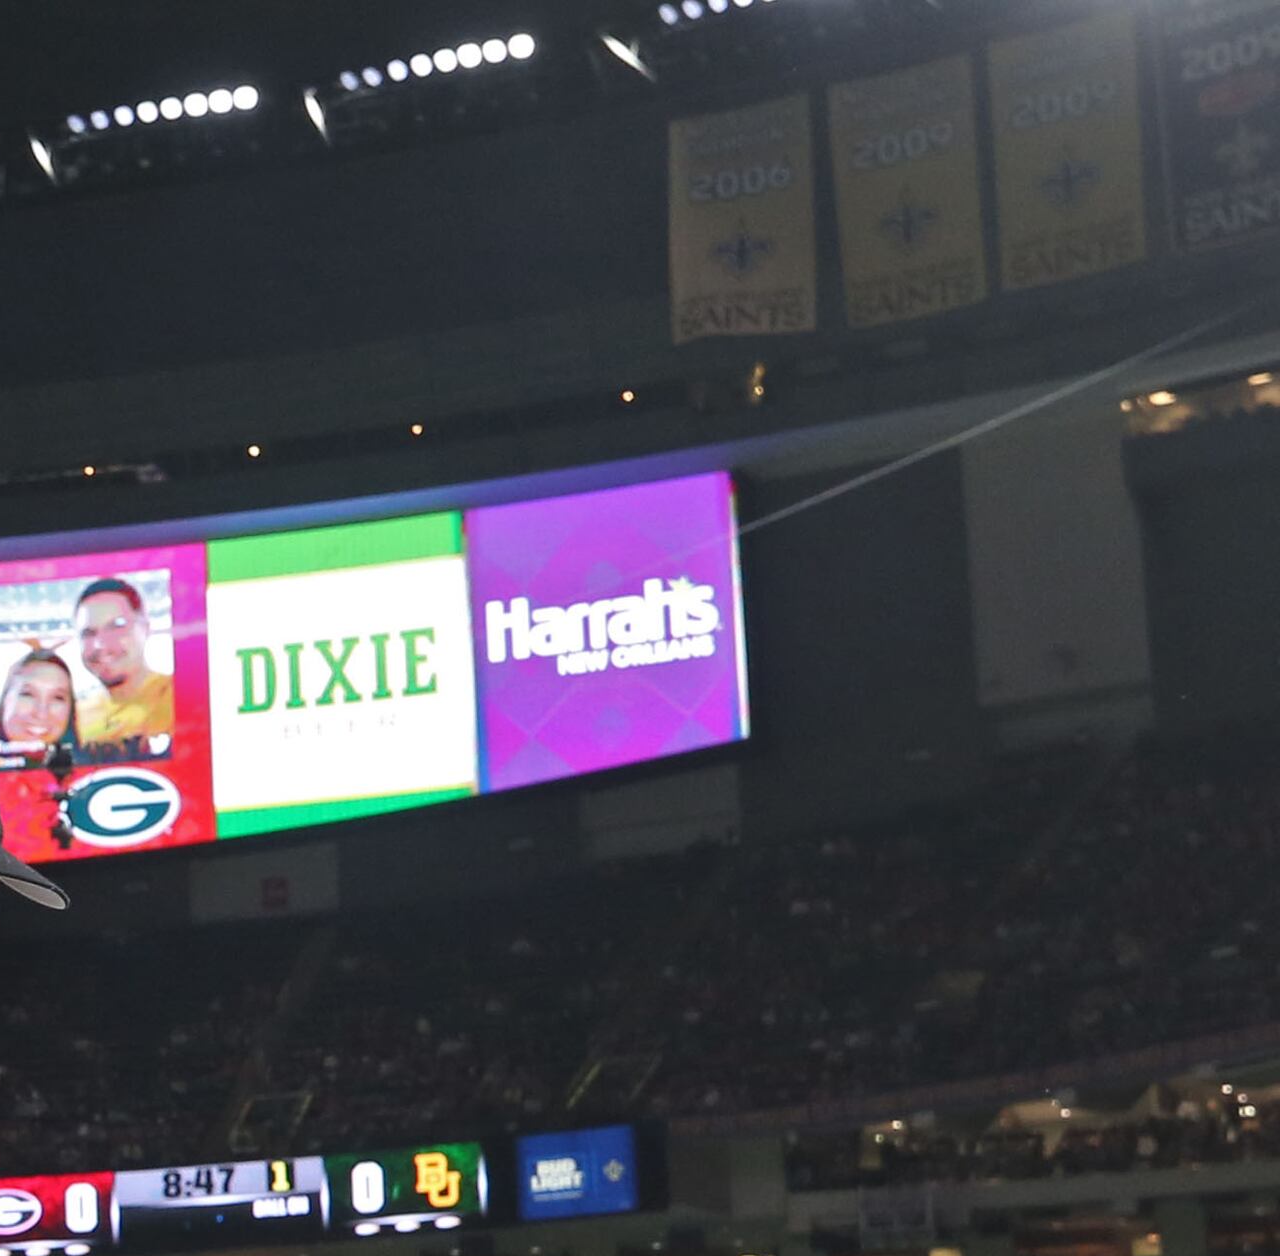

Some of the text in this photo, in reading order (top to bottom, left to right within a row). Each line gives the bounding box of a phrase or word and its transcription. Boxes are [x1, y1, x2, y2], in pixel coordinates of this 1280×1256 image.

[237, 627, 438, 714] DIXIE
[162, 1160, 291, 1199] 8:47 1
